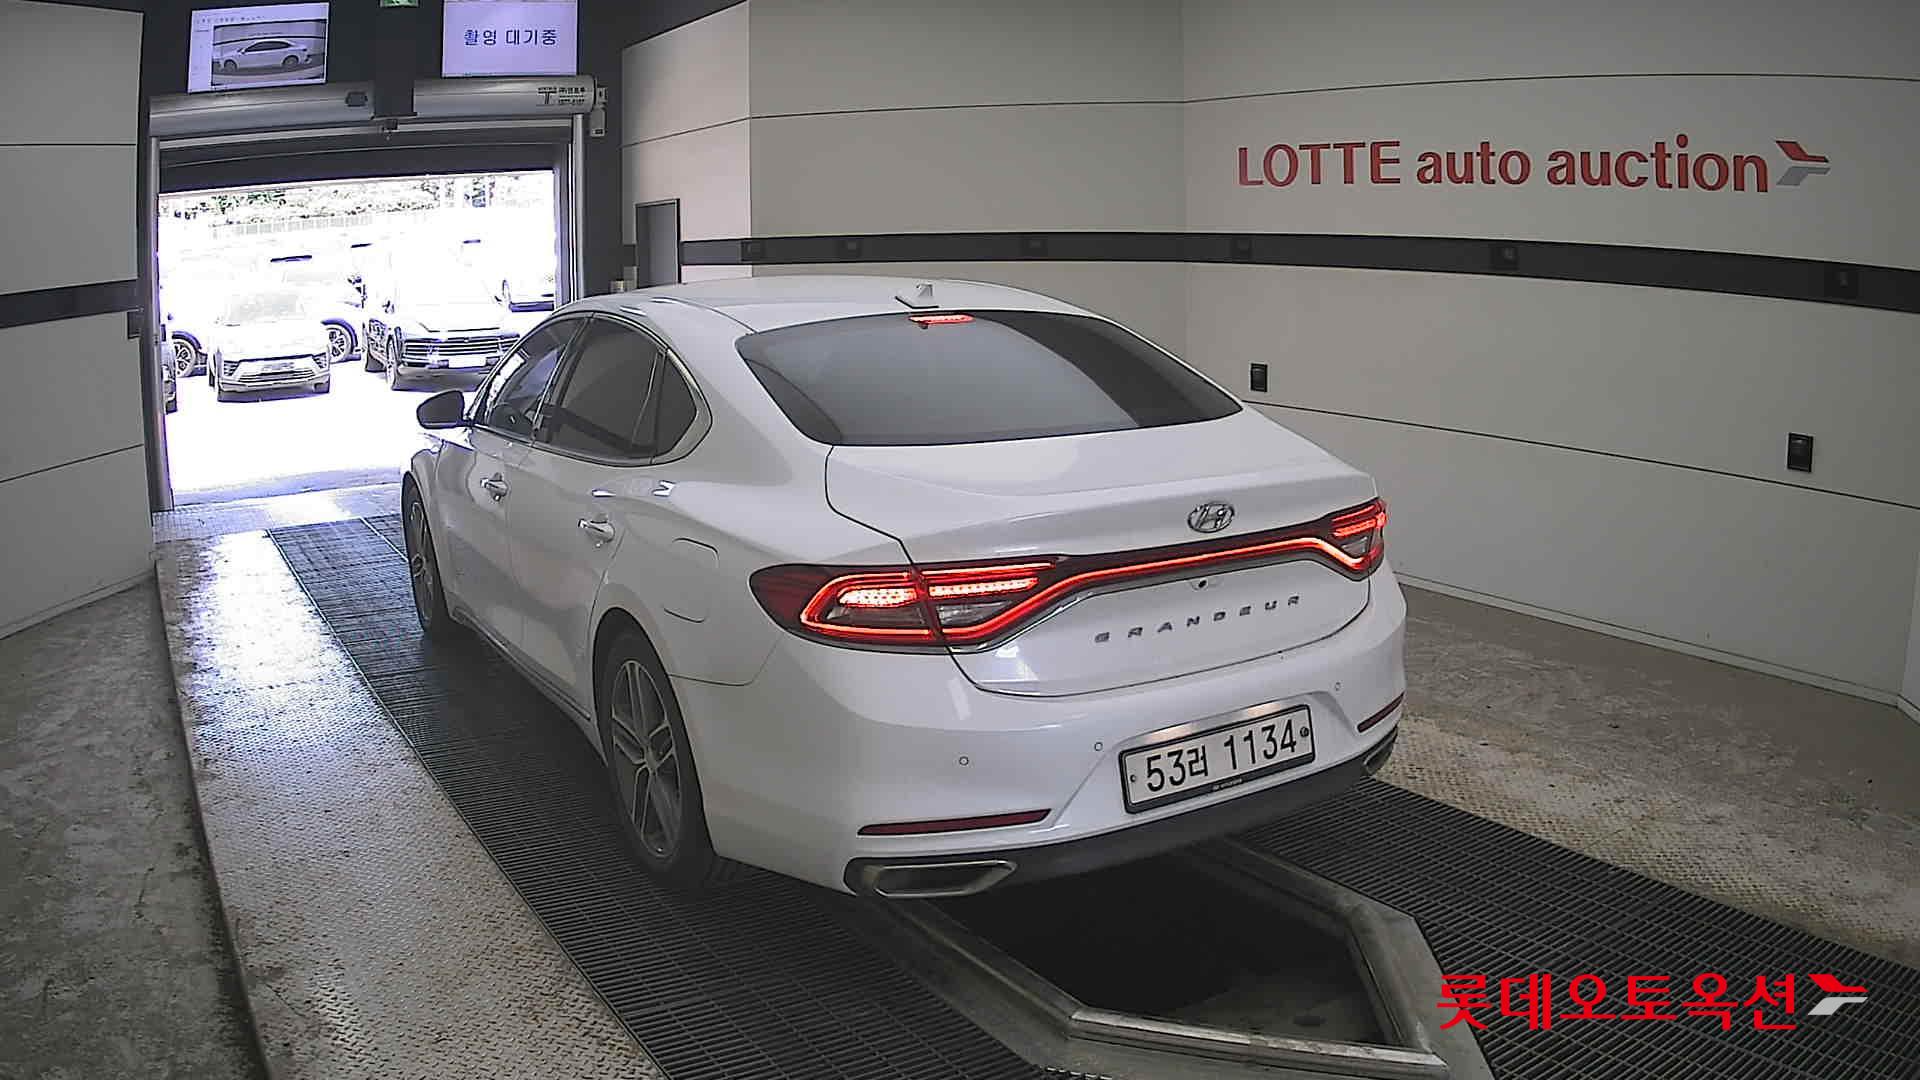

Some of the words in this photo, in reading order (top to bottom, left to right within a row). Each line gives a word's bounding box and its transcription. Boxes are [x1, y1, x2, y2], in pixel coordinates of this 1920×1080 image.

[505, 29, 558, 46] 대기중
[1238, 141, 1401, 187] LOTTE
[1416, 142, 1531, 185] auto
[1547, 133, 1769, 193] auction
[1094, 595, 1300, 643] GRANDEUR
[1146, 744, 1208, 792] 53러
[1223, 719, 1297, 770] 1134
